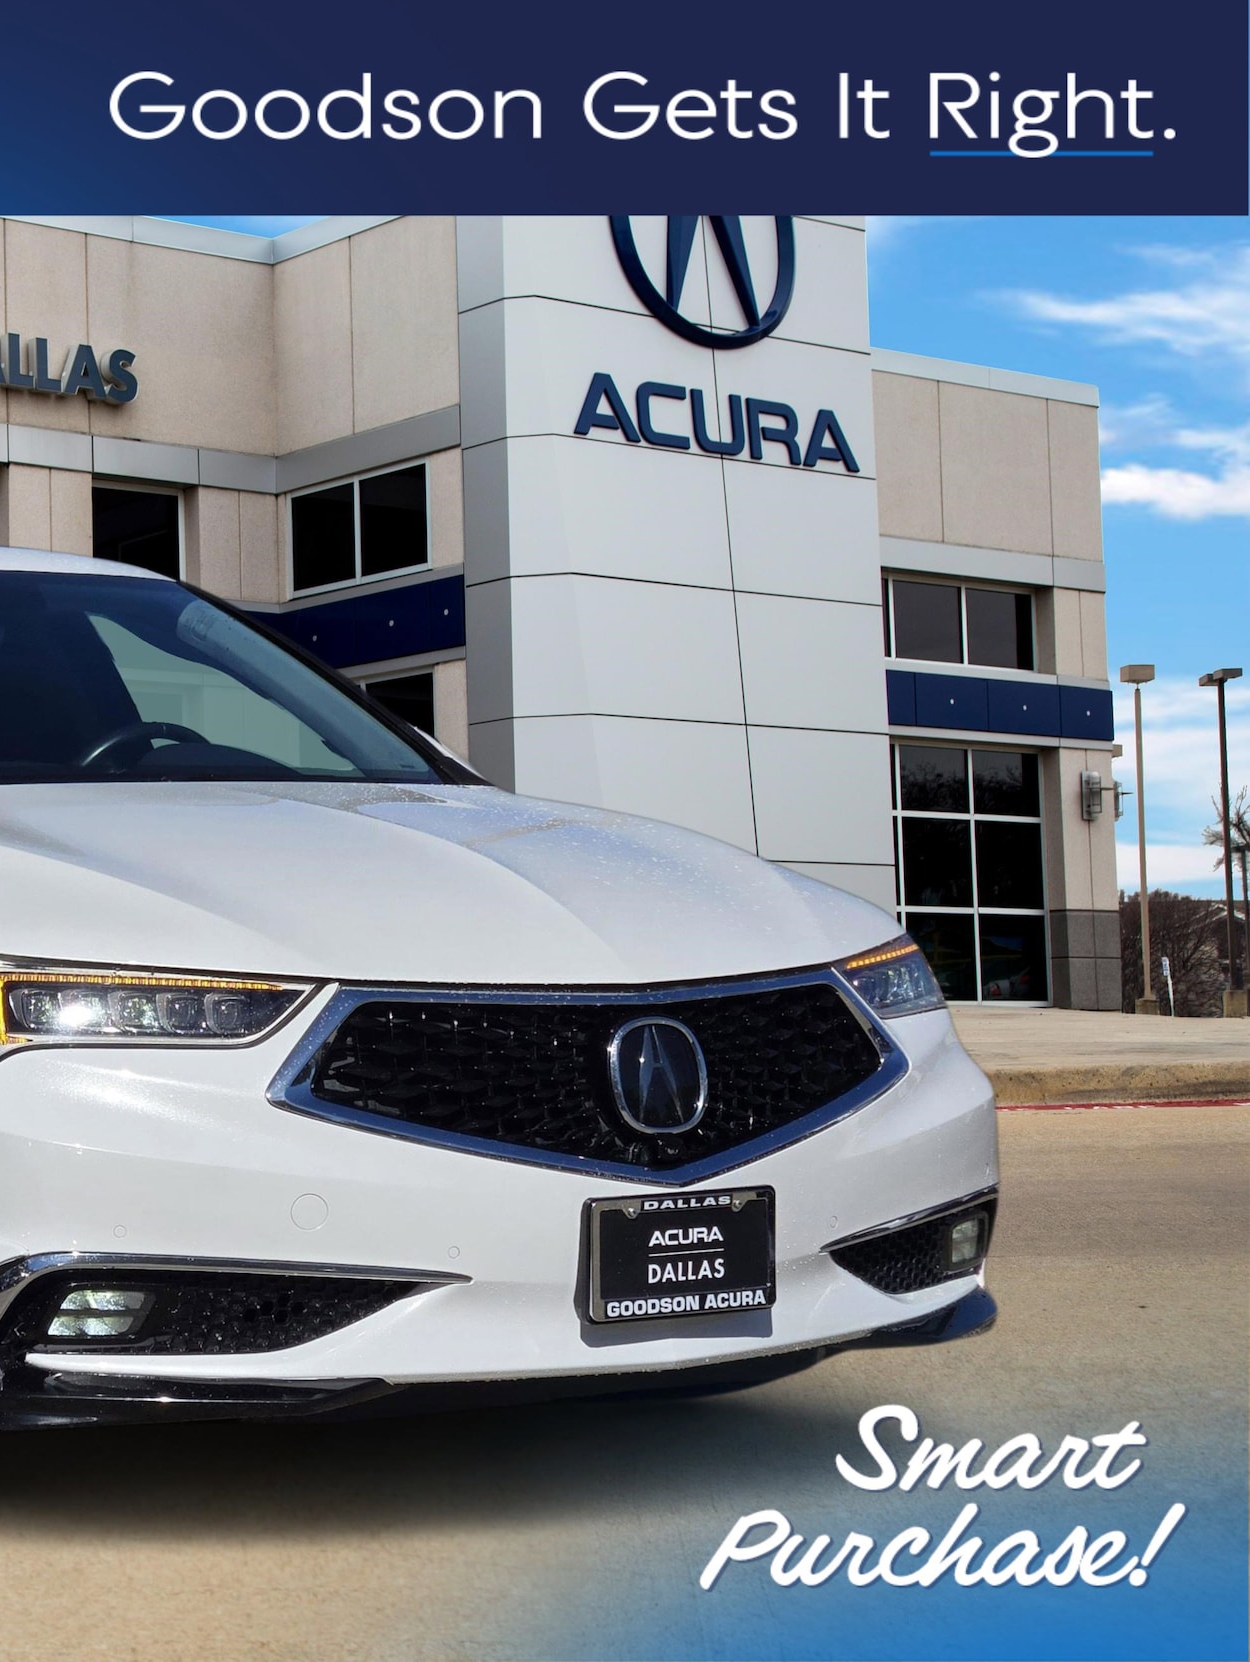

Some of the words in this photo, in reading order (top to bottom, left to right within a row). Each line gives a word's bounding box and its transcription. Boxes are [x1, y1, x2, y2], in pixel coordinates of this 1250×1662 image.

[574, 371, 860, 474] ACURA
[644, 1196, 731, 1210] DALLAS
[648, 1226, 723, 1247] ACURA
[648, 1258, 725, 1284] DALLAS
[607, 1296, 700, 1317] GOODSON
[704, 1290, 766, 1309] ACURA
